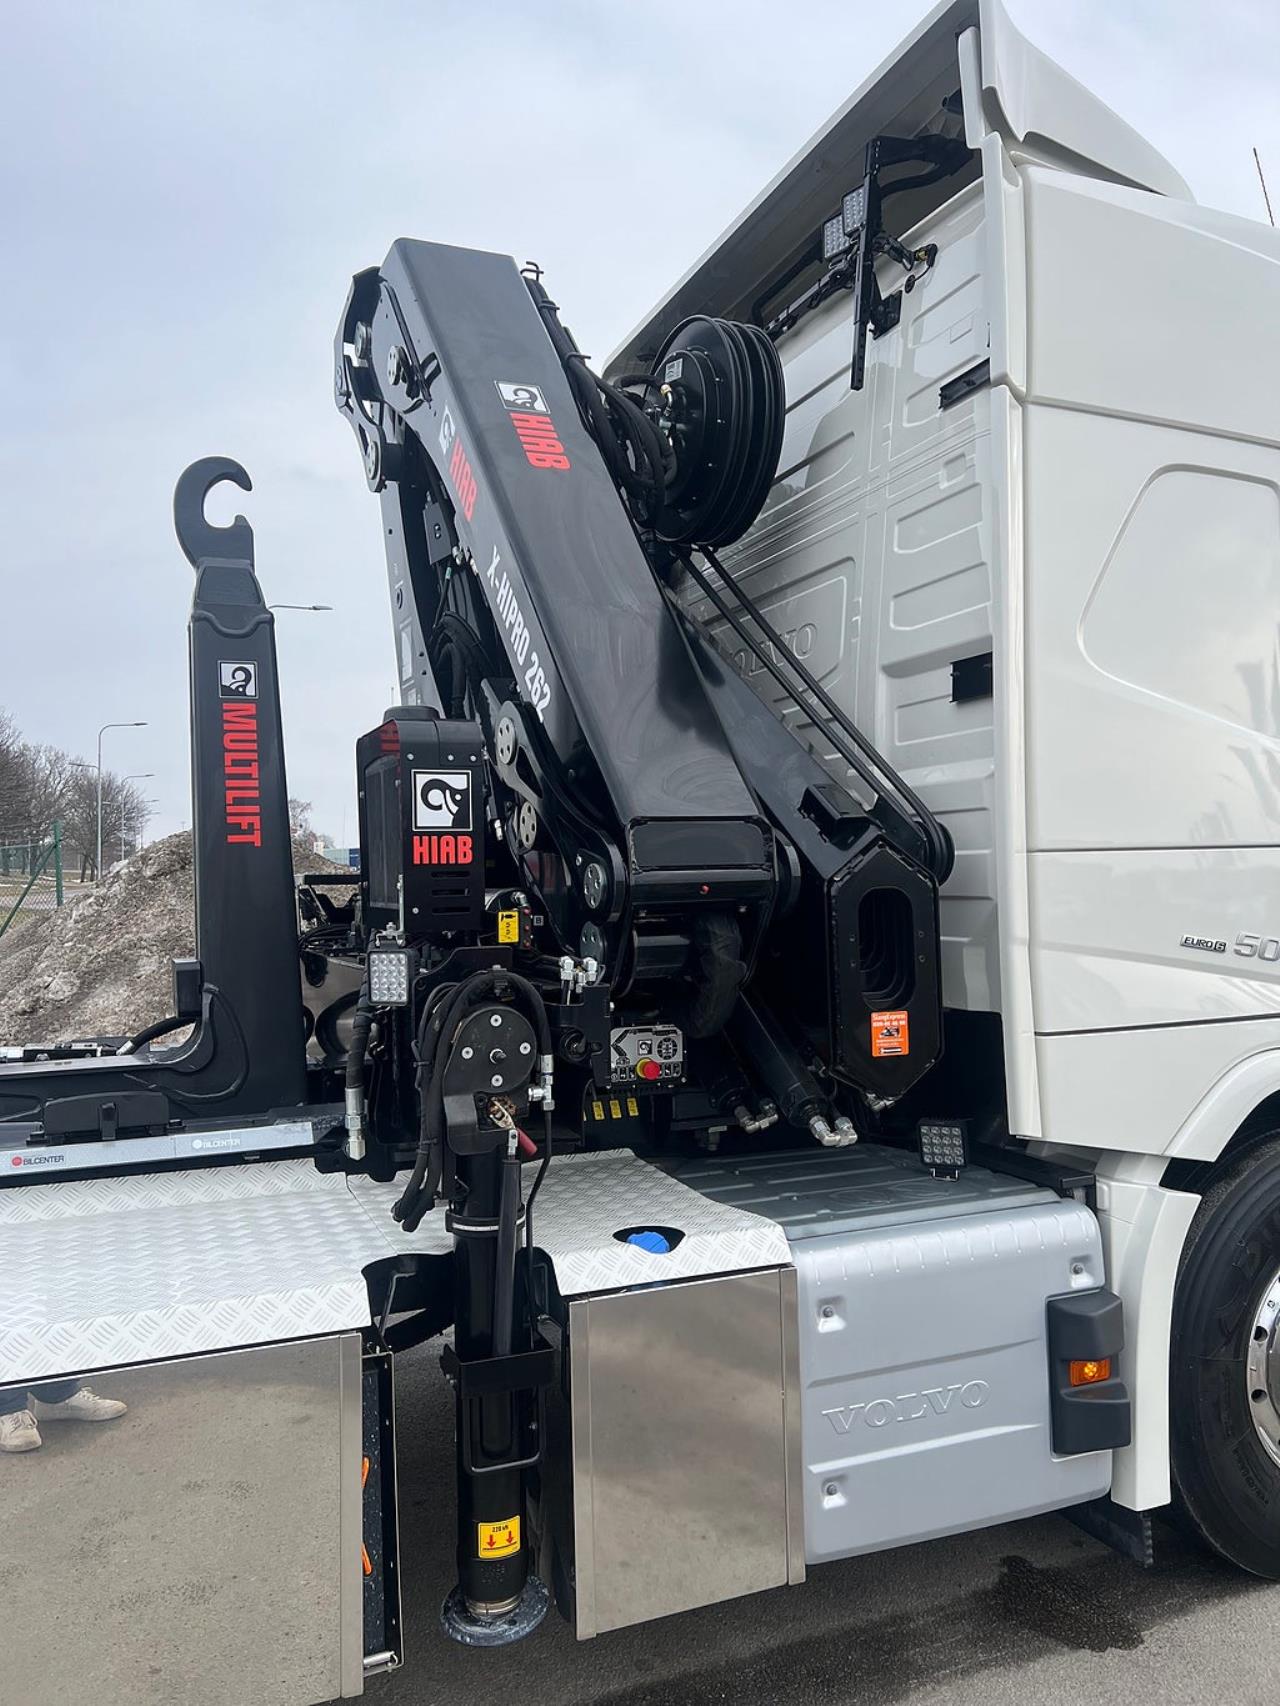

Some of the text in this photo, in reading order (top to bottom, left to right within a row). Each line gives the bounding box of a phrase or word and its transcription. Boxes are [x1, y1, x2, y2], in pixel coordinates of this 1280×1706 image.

[509, 412, 571, 470] HIAB
[450, 436, 477, 522] HIAB
[487, 545, 551, 724] X-HIPRO 262
[222, 703, 261, 847] MULTILIFT
[412, 835, 473, 865] HIAB
[23, 1155, 65, 1166] BILCENTER
[202, 1139, 241, 1149] BILCENTER
[821, 1380, 990, 1434] VOLVO
